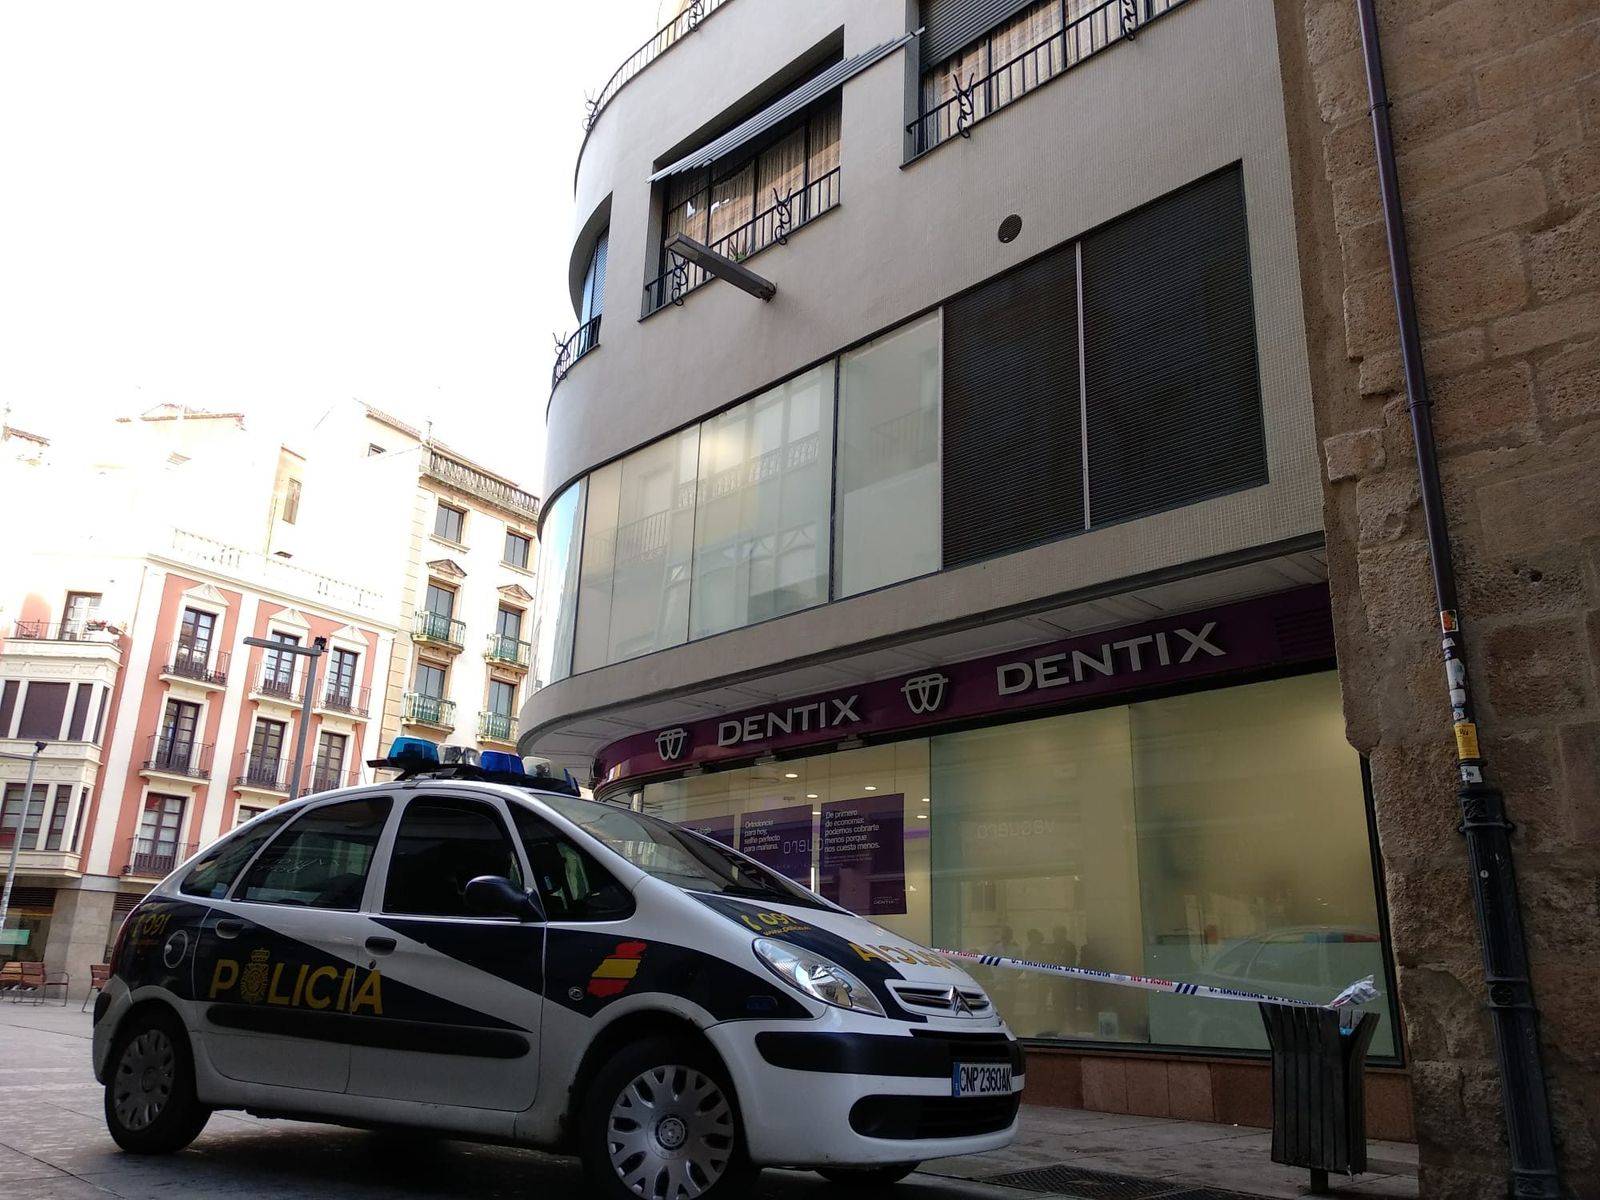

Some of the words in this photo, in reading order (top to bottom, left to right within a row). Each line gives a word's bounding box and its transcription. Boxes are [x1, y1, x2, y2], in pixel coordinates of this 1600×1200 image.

[997, 622, 1227, 696] DENTIX
[717, 695, 863, 747] DENTIX
[824, 827, 853, 837] podemos
[853, 823, 880, 833] cobrarte
[835, 809, 858, 819] primero
